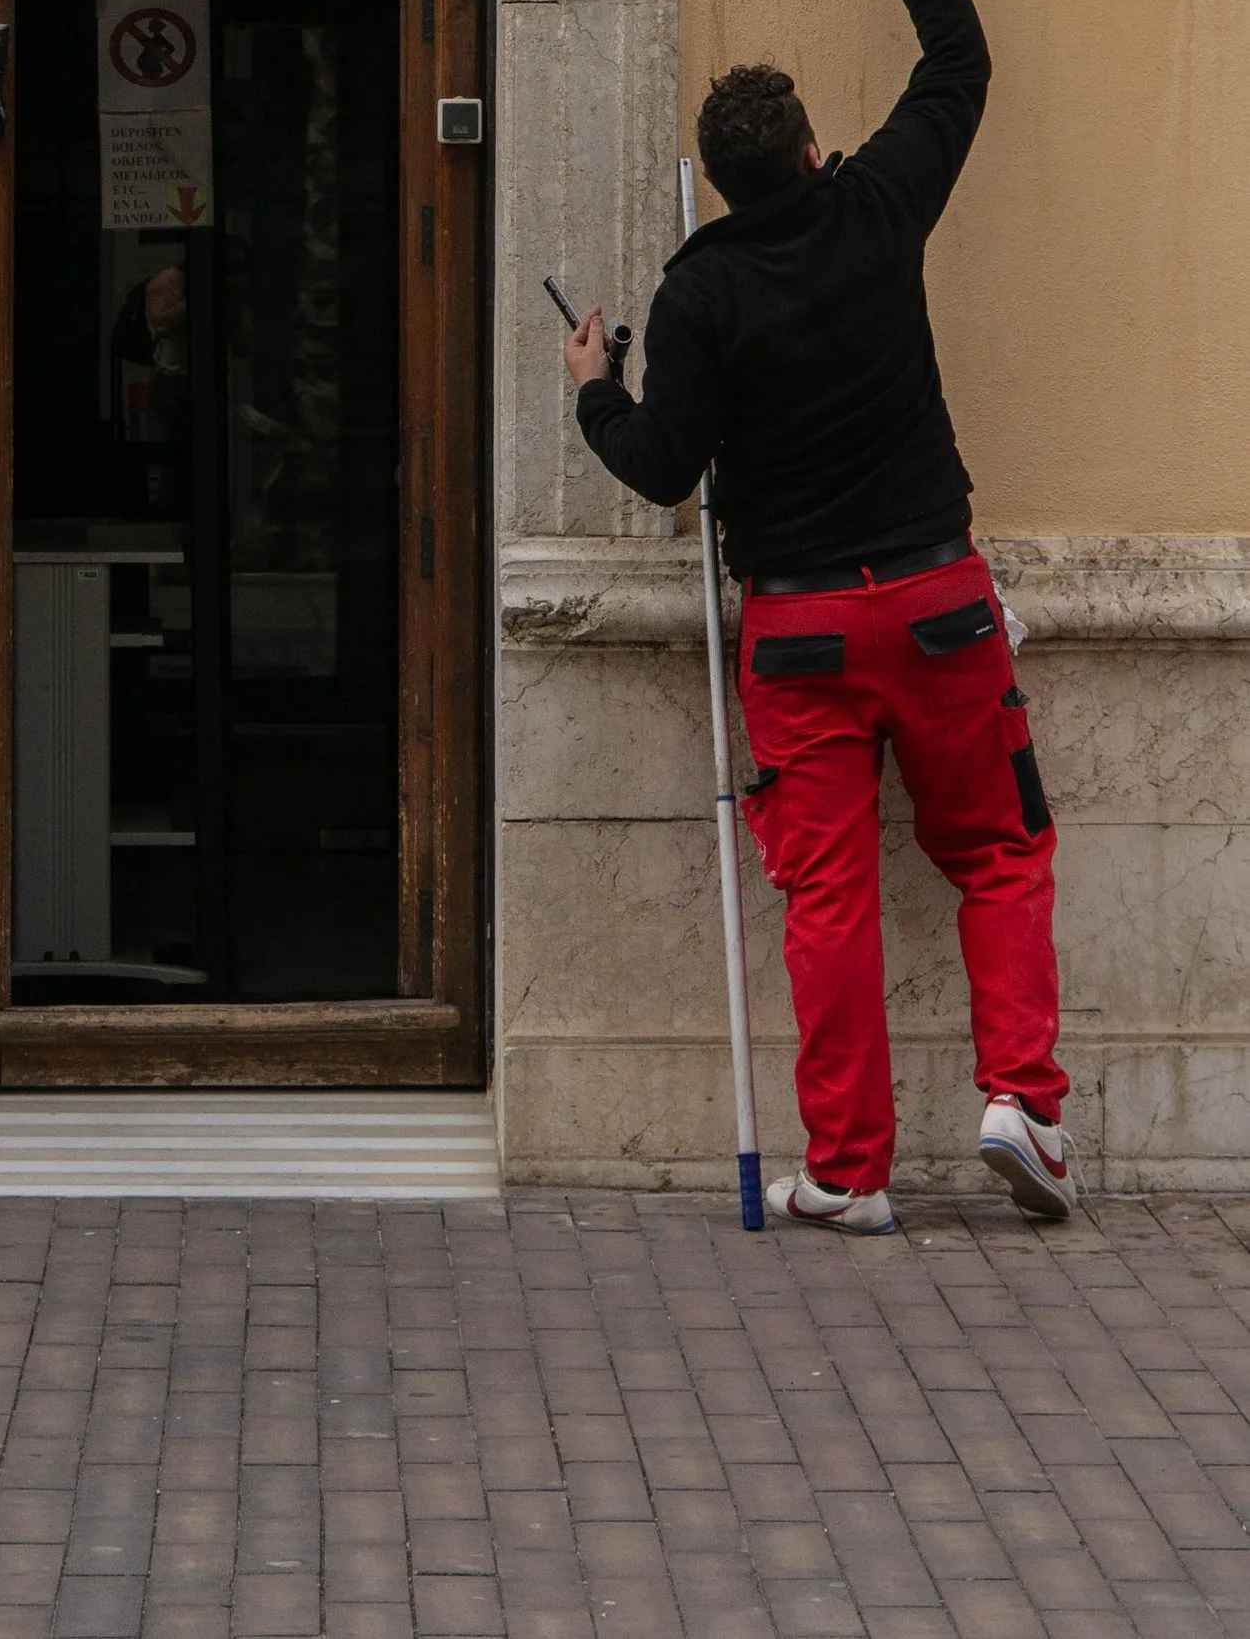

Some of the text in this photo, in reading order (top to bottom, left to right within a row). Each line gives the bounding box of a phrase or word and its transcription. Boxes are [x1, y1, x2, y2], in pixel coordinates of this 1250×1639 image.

[110, 127, 182, 138] DEPOSITEN
[113, 199, 151, 209] EN LA
